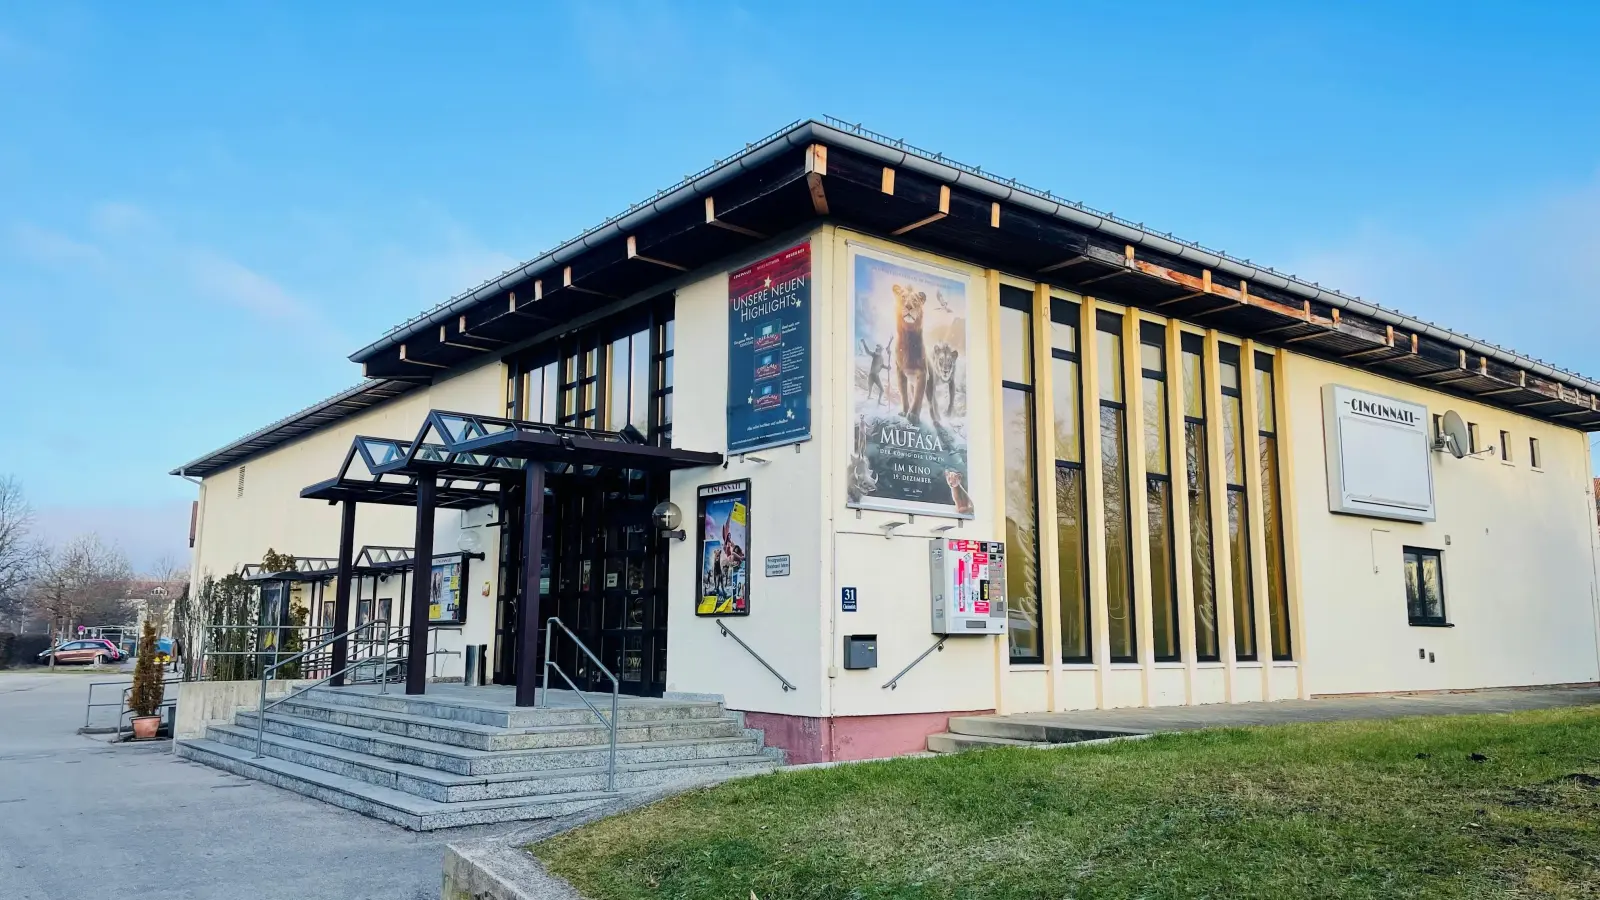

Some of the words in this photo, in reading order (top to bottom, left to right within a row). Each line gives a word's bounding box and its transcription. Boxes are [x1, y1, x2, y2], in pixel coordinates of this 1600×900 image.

[733, 289, 768, 311] UNSERE
[771, 276, 805, 298] NEUEN
[741, 293, 797, 323] HIGHLIGHTS
[1351, 398, 1414, 423] CINCINNATI
[880, 427, 944, 452] MUFASA
[894, 462, 905, 473] IM
[908, 464, 931, 476] KINO
[902, 474, 932, 484] DEZEMBER
[844, 588, 855, 601] 31
